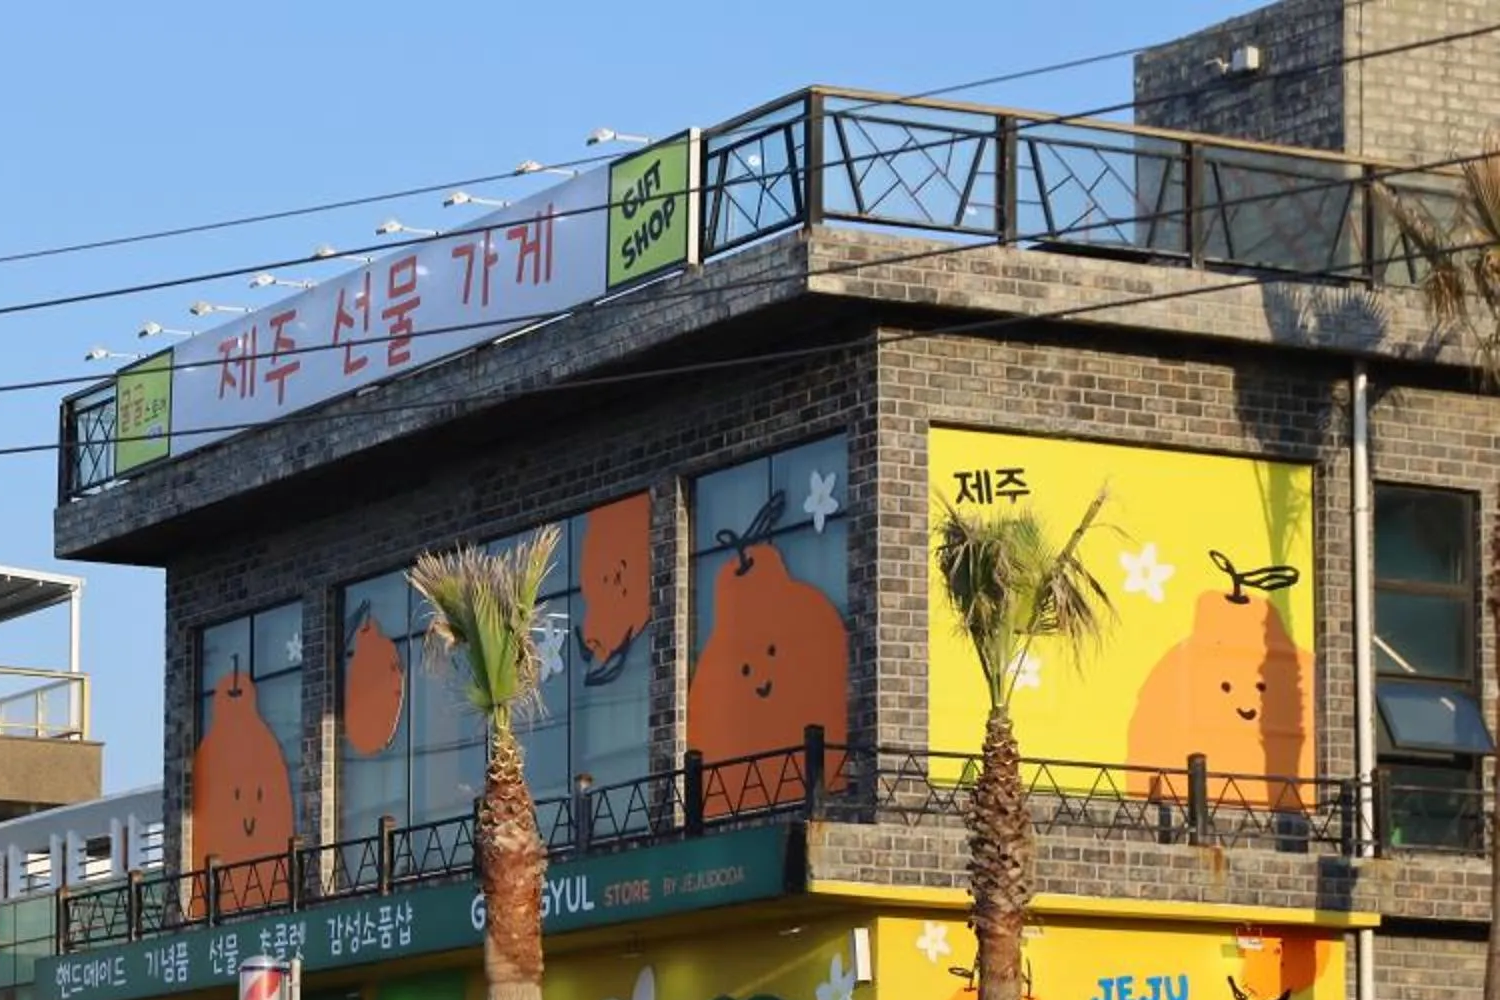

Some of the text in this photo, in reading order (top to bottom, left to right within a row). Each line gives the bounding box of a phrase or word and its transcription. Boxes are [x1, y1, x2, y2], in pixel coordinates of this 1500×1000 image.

[621, 160, 661, 220] GIFT
[621, 195, 676, 269] SHOP
[218, 202, 554, 406] 제주 선물 가게
[953, 468, 1030, 504] 제주
[471, 875, 595, 930] GGYUL
[604, 880, 651, 907] STORE
[55, 957, 127, 999] 핸드메이드
[145, 941, 190, 985] 기념품
[209, 933, 240, 976] 선물
[327, 900, 414, 956] 감성소품샵
